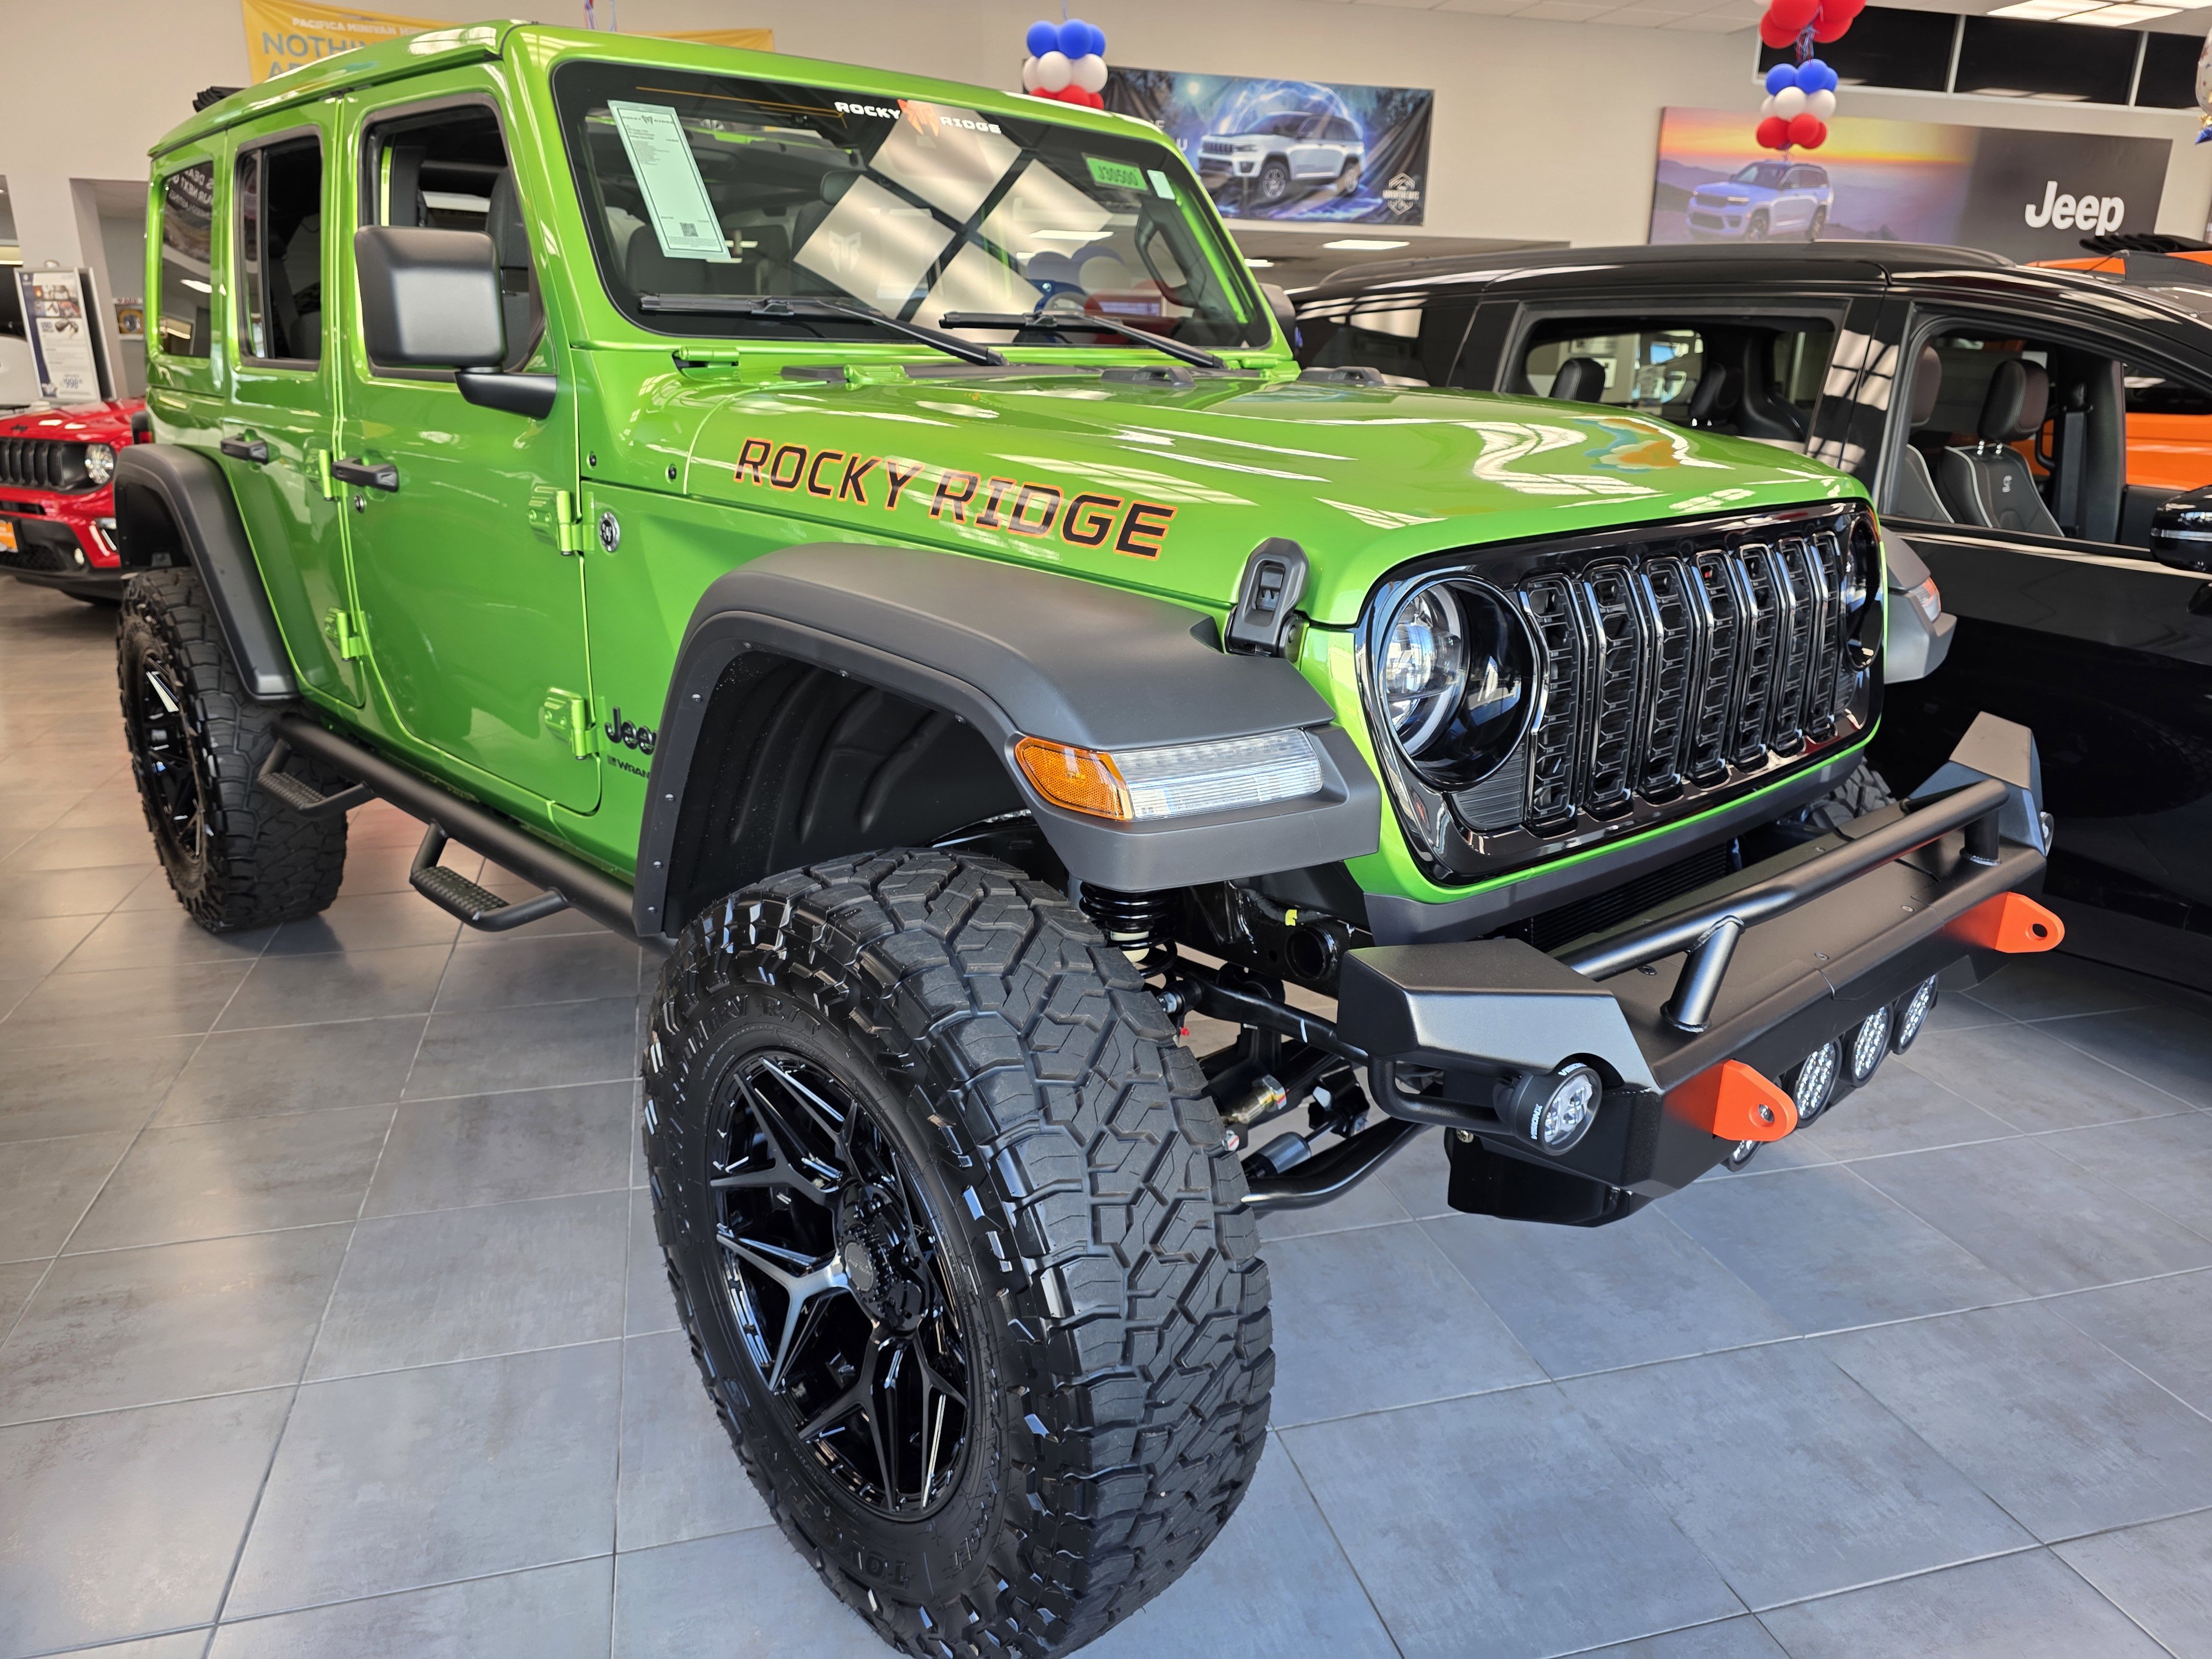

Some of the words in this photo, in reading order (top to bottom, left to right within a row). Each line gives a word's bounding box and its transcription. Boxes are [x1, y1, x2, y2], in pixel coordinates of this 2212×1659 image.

[262, 32, 366, 58] NOTH
[834, 101, 900, 119] ROCKY
[939, 116, 1002, 134] RIDGE
[2025, 180, 2125, 236] Jeep
[733, 436, 925, 511] ROCKY
[928, 470, 1178, 561] RIDGE
[604, 706, 658, 755] Jee
